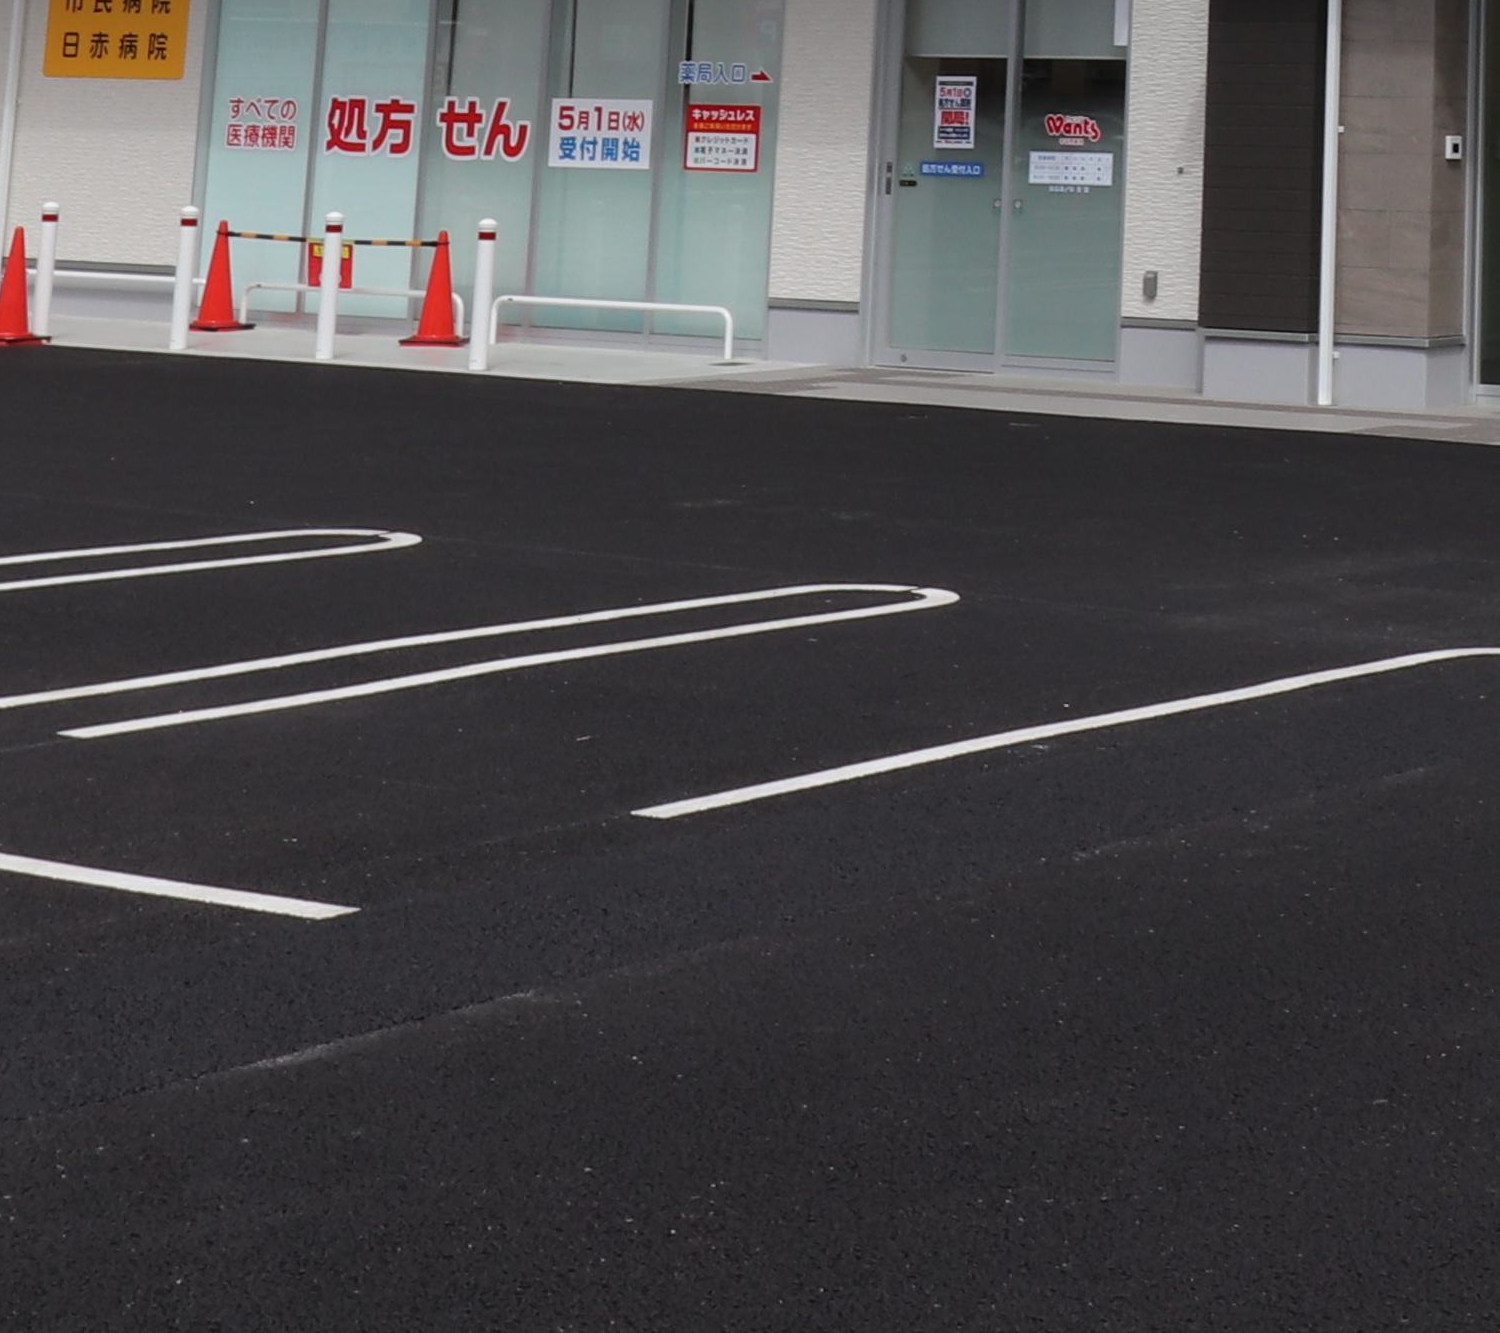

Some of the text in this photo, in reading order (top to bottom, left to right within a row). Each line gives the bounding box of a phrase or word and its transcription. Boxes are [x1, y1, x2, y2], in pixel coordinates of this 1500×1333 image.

[62, 32, 168, 60] 日赤病院
[679, 62, 747, 83] 薬局入口
[229, 97, 297, 121] すべての
[558, 105, 646, 132] 5月1日(水)
[692, 108, 755, 121] キャッシュレス
[226, 124, 296, 149] 医療機関
[325, 96, 530, 159] 処方せん
[1045, 114, 1101, 142] Wants
[558, 136, 641, 162] 受付開始
[922, 163, 981, 175] 処方せん受付入口
